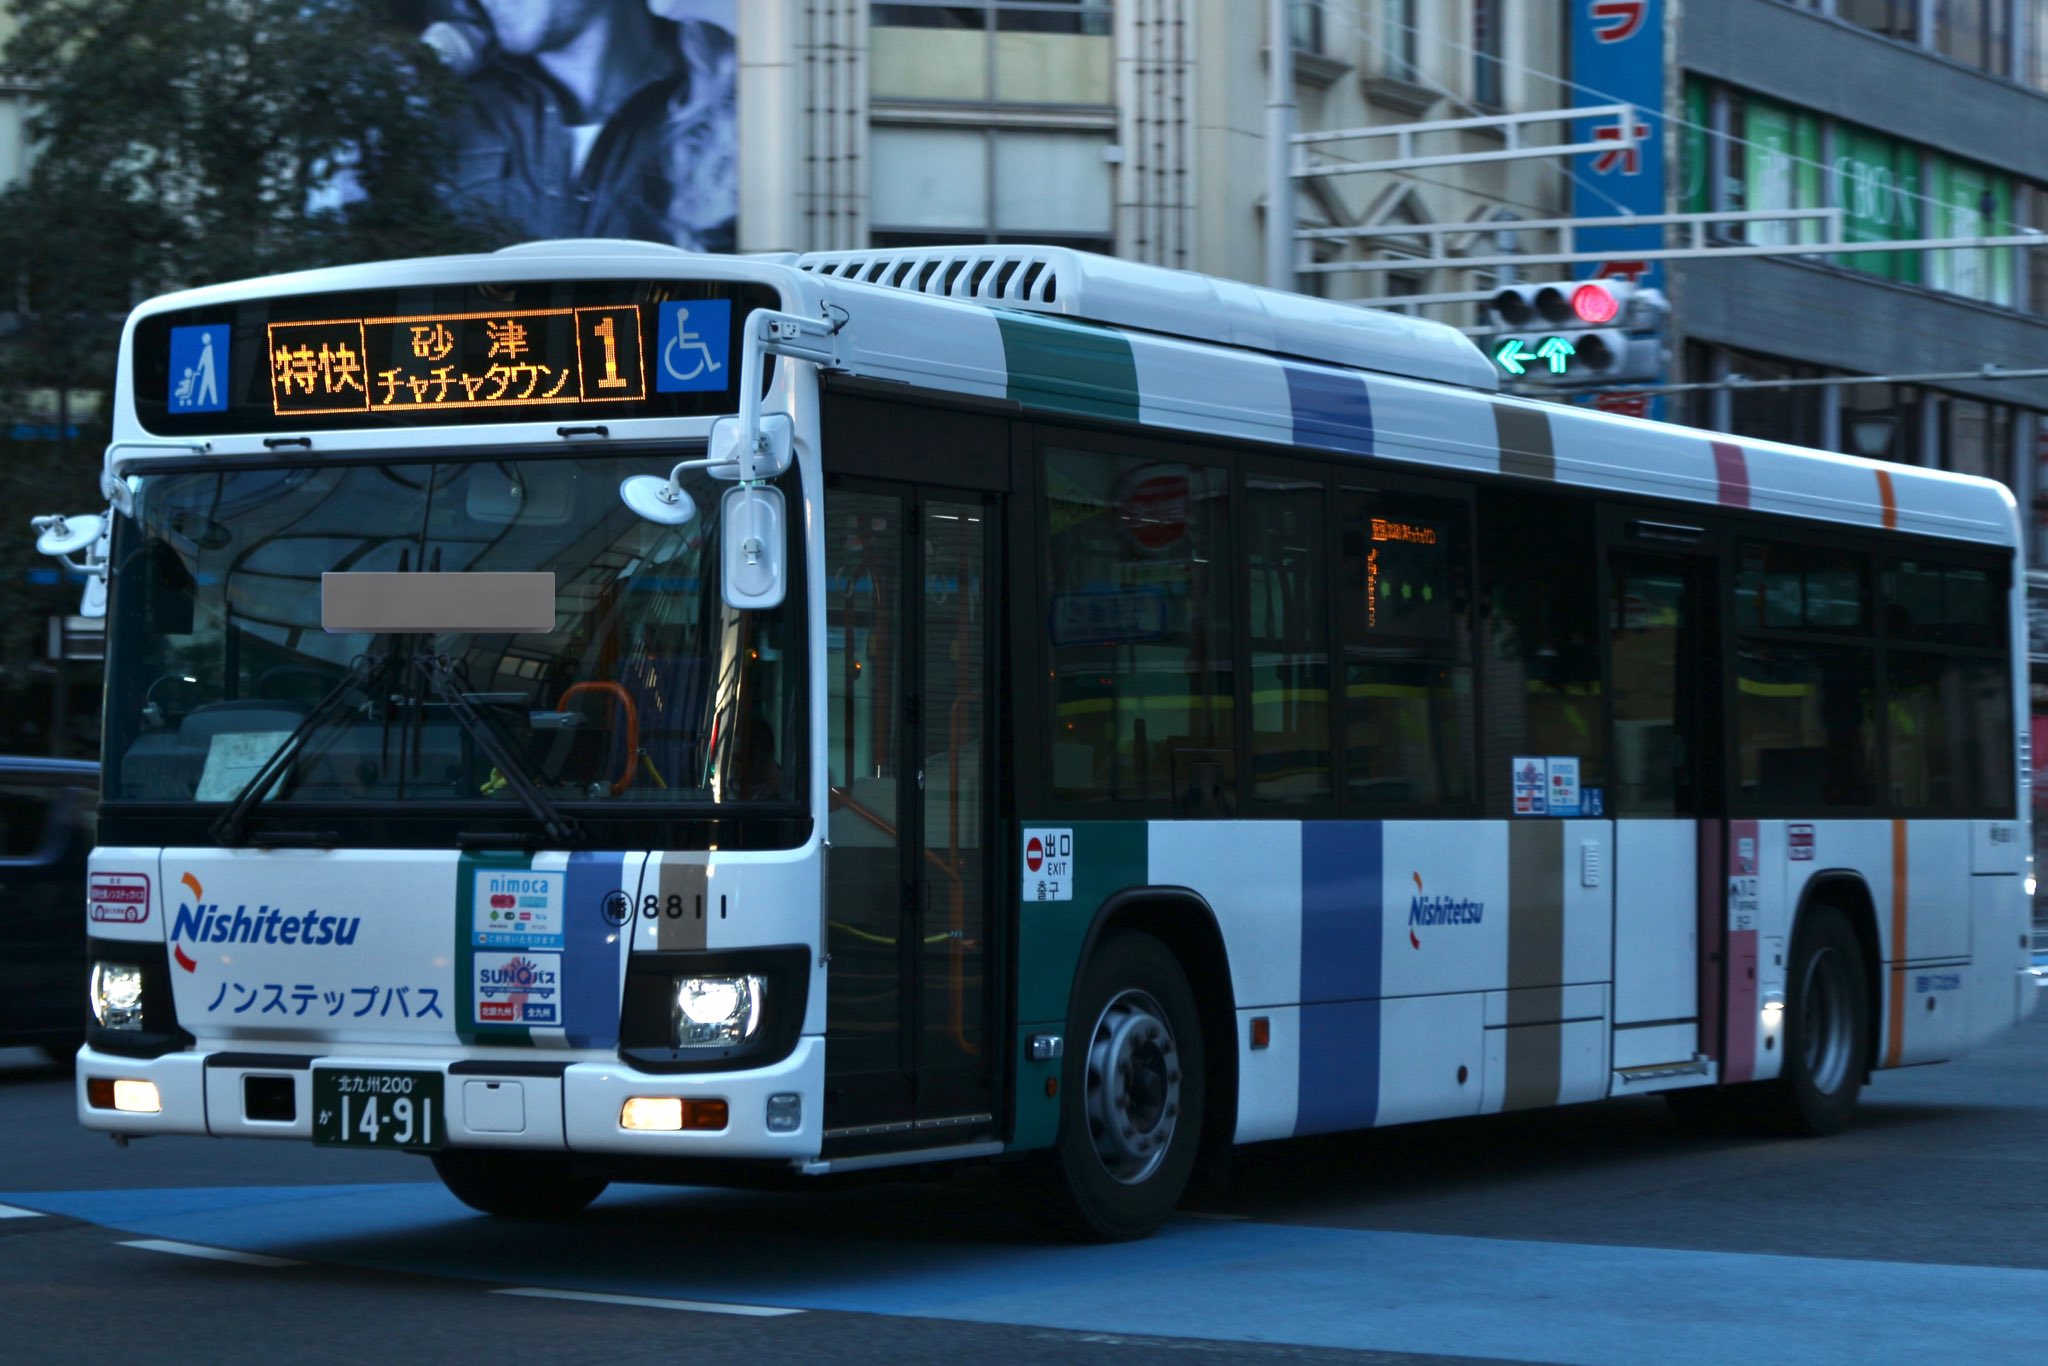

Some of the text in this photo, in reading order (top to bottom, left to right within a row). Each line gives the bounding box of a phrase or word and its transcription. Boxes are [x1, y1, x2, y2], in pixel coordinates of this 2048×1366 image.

[594, 316, 627, 389] 1
[276, 341, 364, 396] 特快
[378, 361, 569, 404] チャチャタウン
[1044, 833, 1071, 858] 出口
[1047, 862, 1067, 876] EXIT
[490, 874, 549, 894] nimoca
[1037, 881, 1059, 900] 출구
[642, 895, 727, 919] 8811
[1408, 895, 1485, 927] Nishitetsu
[170, 903, 361, 946] Nishitetsu
[207, 982, 444, 1020] ノンステップバス
[528, 1008, 551, 1018] 全九州
[338, 1076, 414, 1094] 北九州200
[319, 1095, 432, 1144] か 14-91
